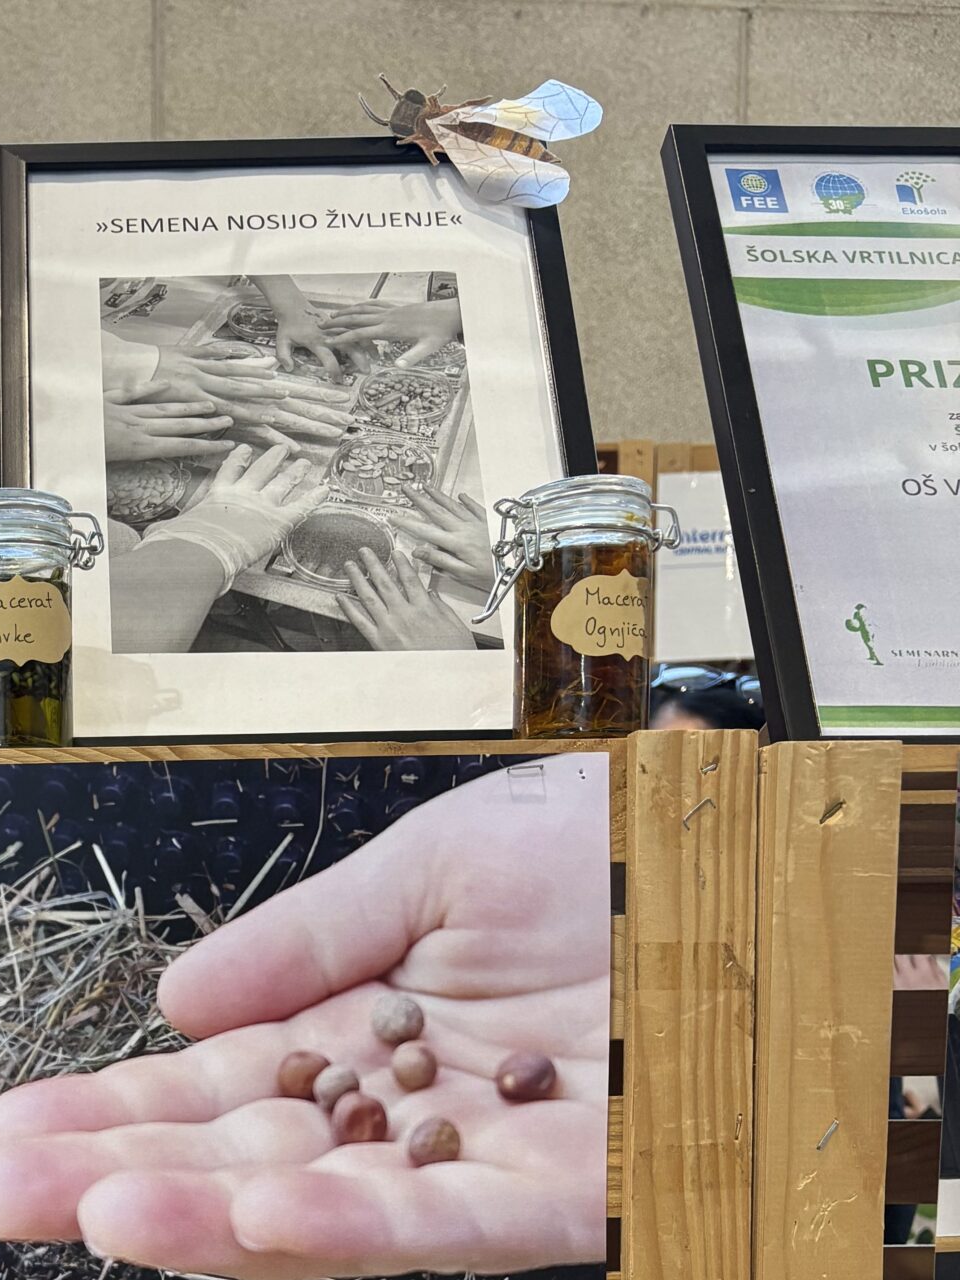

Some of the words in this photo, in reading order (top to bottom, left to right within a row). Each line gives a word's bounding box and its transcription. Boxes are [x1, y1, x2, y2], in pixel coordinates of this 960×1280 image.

[741, 197, 779, 209] FEE
[829, 200, 844, 210] 30
[902, 207, 947, 216] Ekošola
[96, 217, 218, 234] »SEMENA
[227, 213, 318, 231] NOSIJO
[325, 209, 462, 229] ŽIVLJENJE«
[746, 245, 837, 264] ŠOLSKA
[929, 444, 938, 452] v
[901, 473, 938, 496] OŠ
[585, 587, 648, 607] Macera
